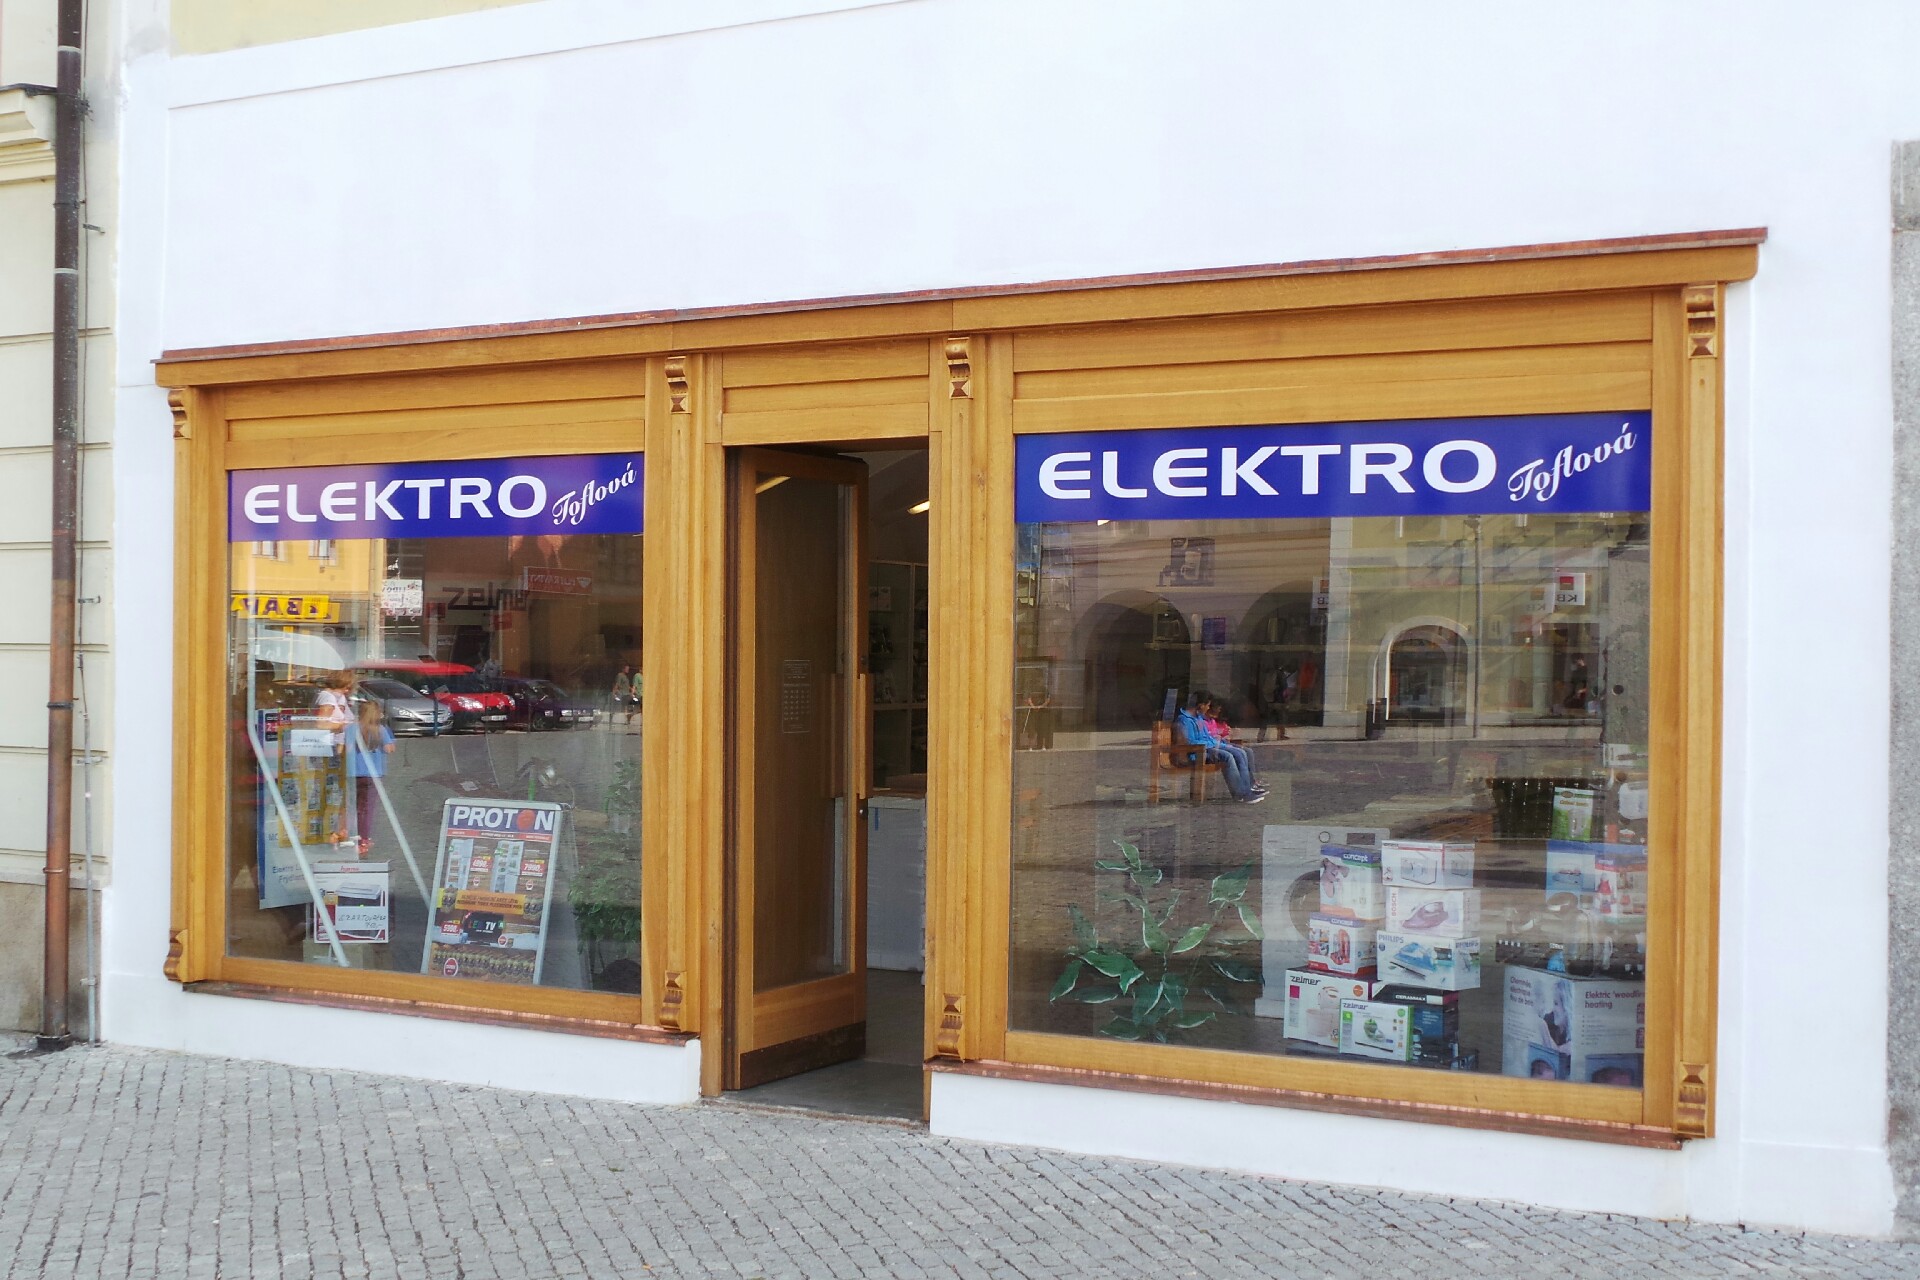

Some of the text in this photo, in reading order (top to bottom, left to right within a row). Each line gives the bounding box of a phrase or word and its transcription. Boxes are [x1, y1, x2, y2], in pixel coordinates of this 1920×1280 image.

[1039, 421, 1638, 504] ELEKTRO Toflová
[243, 461, 638, 527] ELEKTRO Toflová
[1342, 853, 1369, 863] concept
[1378, 934, 1404, 943] PHILIPS
[1289, 975, 1321, 986] zelmer
[1343, 1002, 1369, 1011] zelmer
